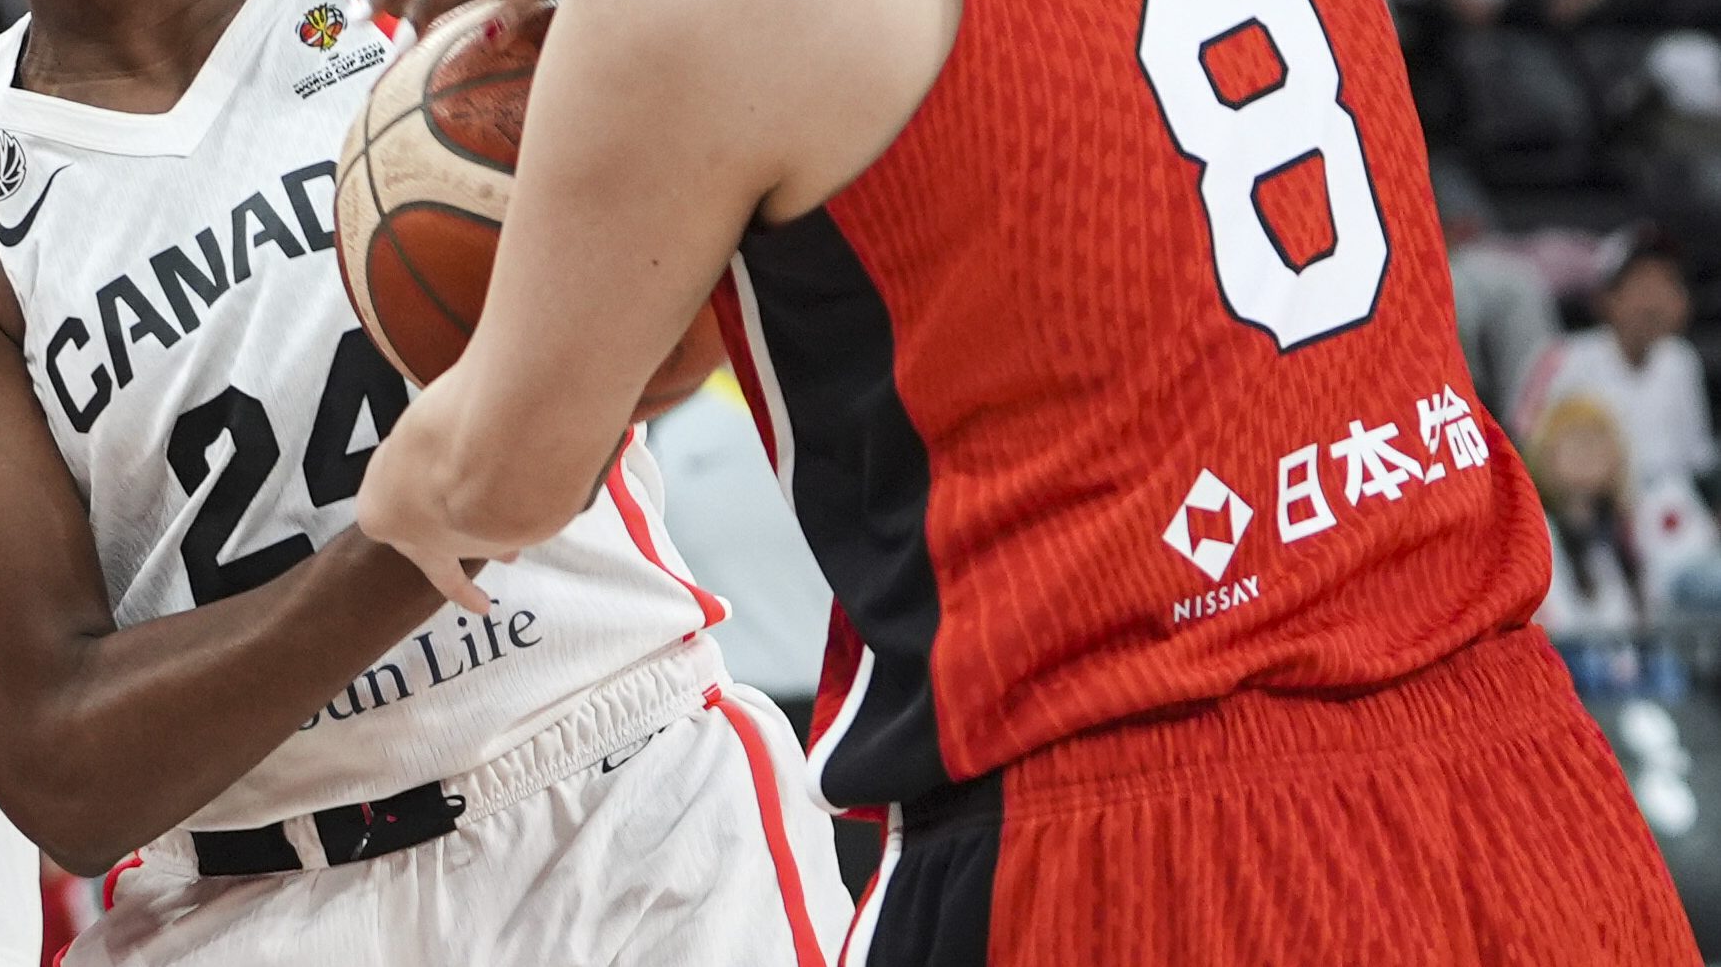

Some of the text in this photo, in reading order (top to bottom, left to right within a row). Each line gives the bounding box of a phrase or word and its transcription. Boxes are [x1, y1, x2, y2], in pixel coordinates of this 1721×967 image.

[334, 58, 357, 74] CUP
[46, 159, 338, 434] CANAD
[167, 327, 409, 608] 24
[298, 598, 543, 731] un Life
[1173, 575, 1261, 623] NISSAY
